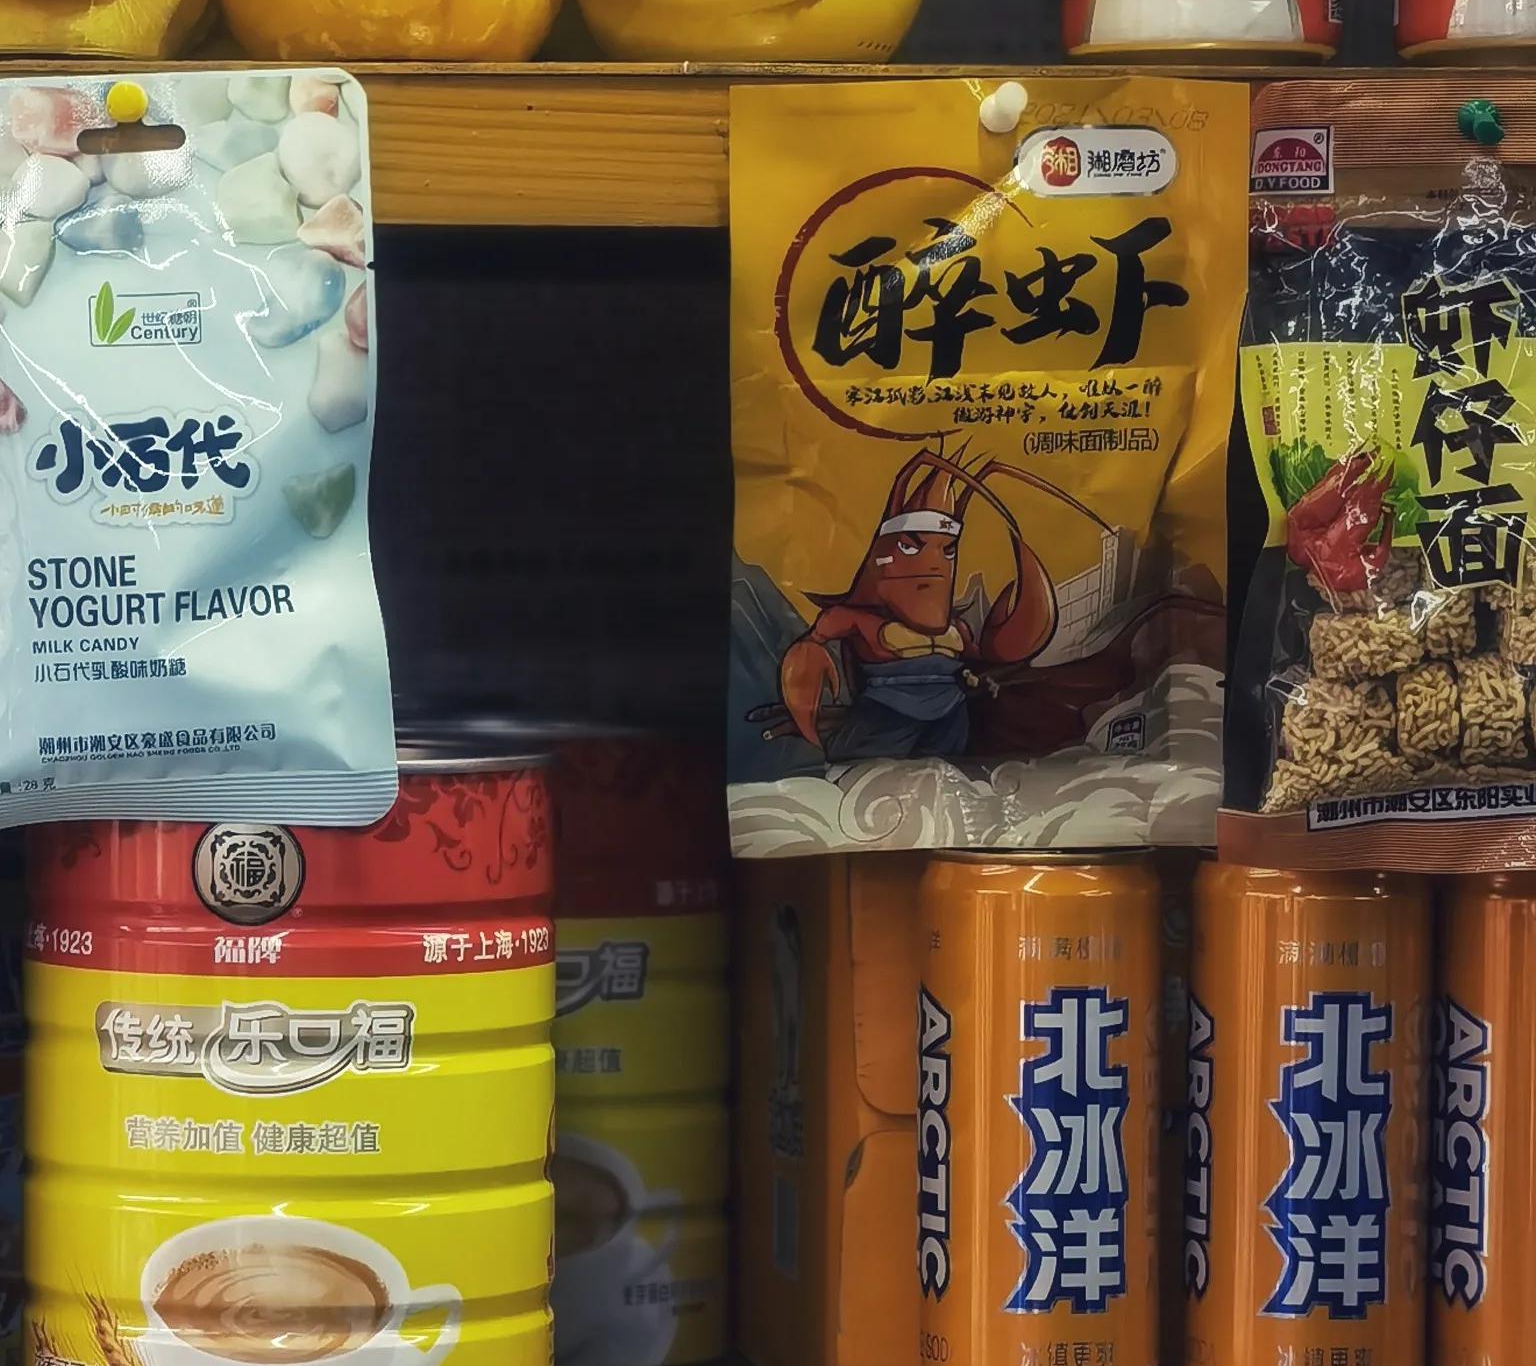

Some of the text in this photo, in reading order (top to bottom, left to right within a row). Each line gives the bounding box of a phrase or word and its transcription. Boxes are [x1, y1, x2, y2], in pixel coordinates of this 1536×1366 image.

[1279, 177, 1321, 188] FOOD
[811, 216, 1190, 384] 醉虾
[129, 323, 199, 345] Century
[35, 414, 251, 494] 小石代
[1022, 427, 1161, 455] (调味面制品)
[1404, 283, 1527, 588] 虾仔面
[28, 555, 136, 592] STONE
[28, 583, 295, 630] YOGURT FLAVOR
[32, 636, 140, 654] MILK CANDY
[33, 658, 188, 683] 小石代乳酸味奶糖
[125, 1117, 382, 1156] 营养加值 健康超值
[919, 992, 952, 1303] ARCTIC
[1026, 998, 1125, 1307] 北冰洋
[1185, 996, 1215, 1301] ARCTIC
[1284, 1002, 1388, 1309] 北冰洋
[1445, 1002, 1493, 1309] ARCTIC
